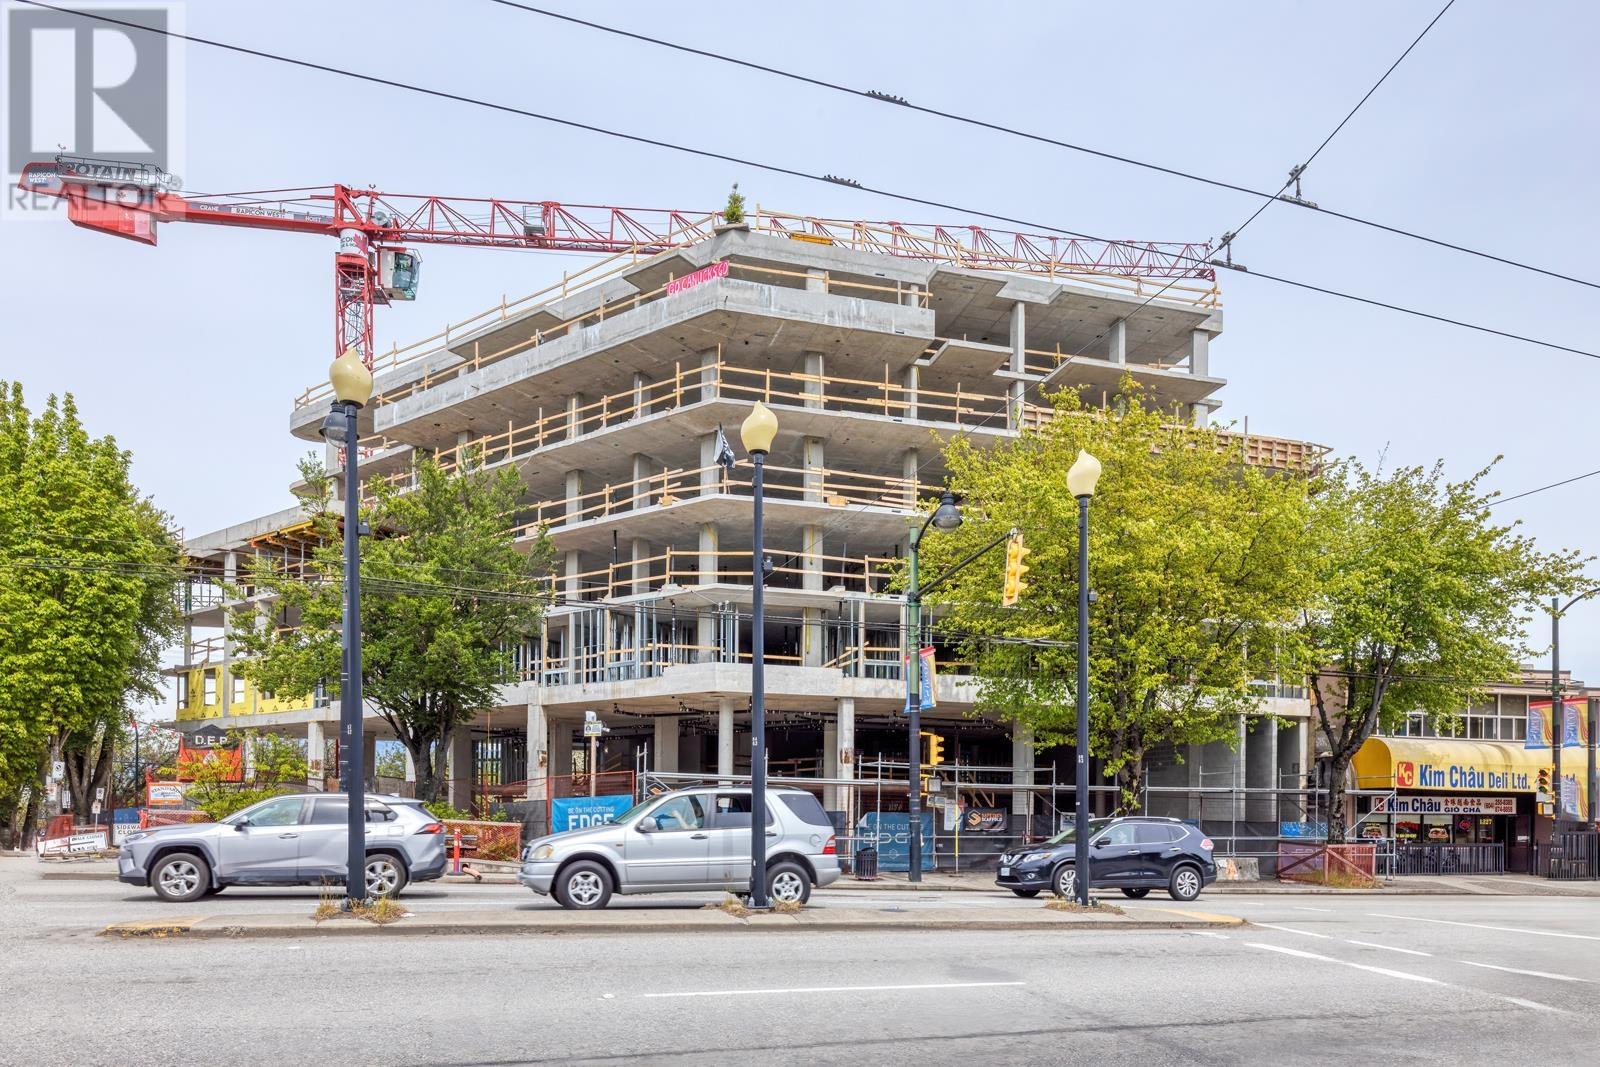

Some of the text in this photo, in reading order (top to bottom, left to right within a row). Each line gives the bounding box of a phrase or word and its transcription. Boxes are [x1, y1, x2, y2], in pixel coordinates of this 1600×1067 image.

[61, 162, 136, 181] POTAIN
[1420, 764, 1530, 790] Kim Châu Deli Ltd.
[1388, 798, 1441, 812] Kim Châu
